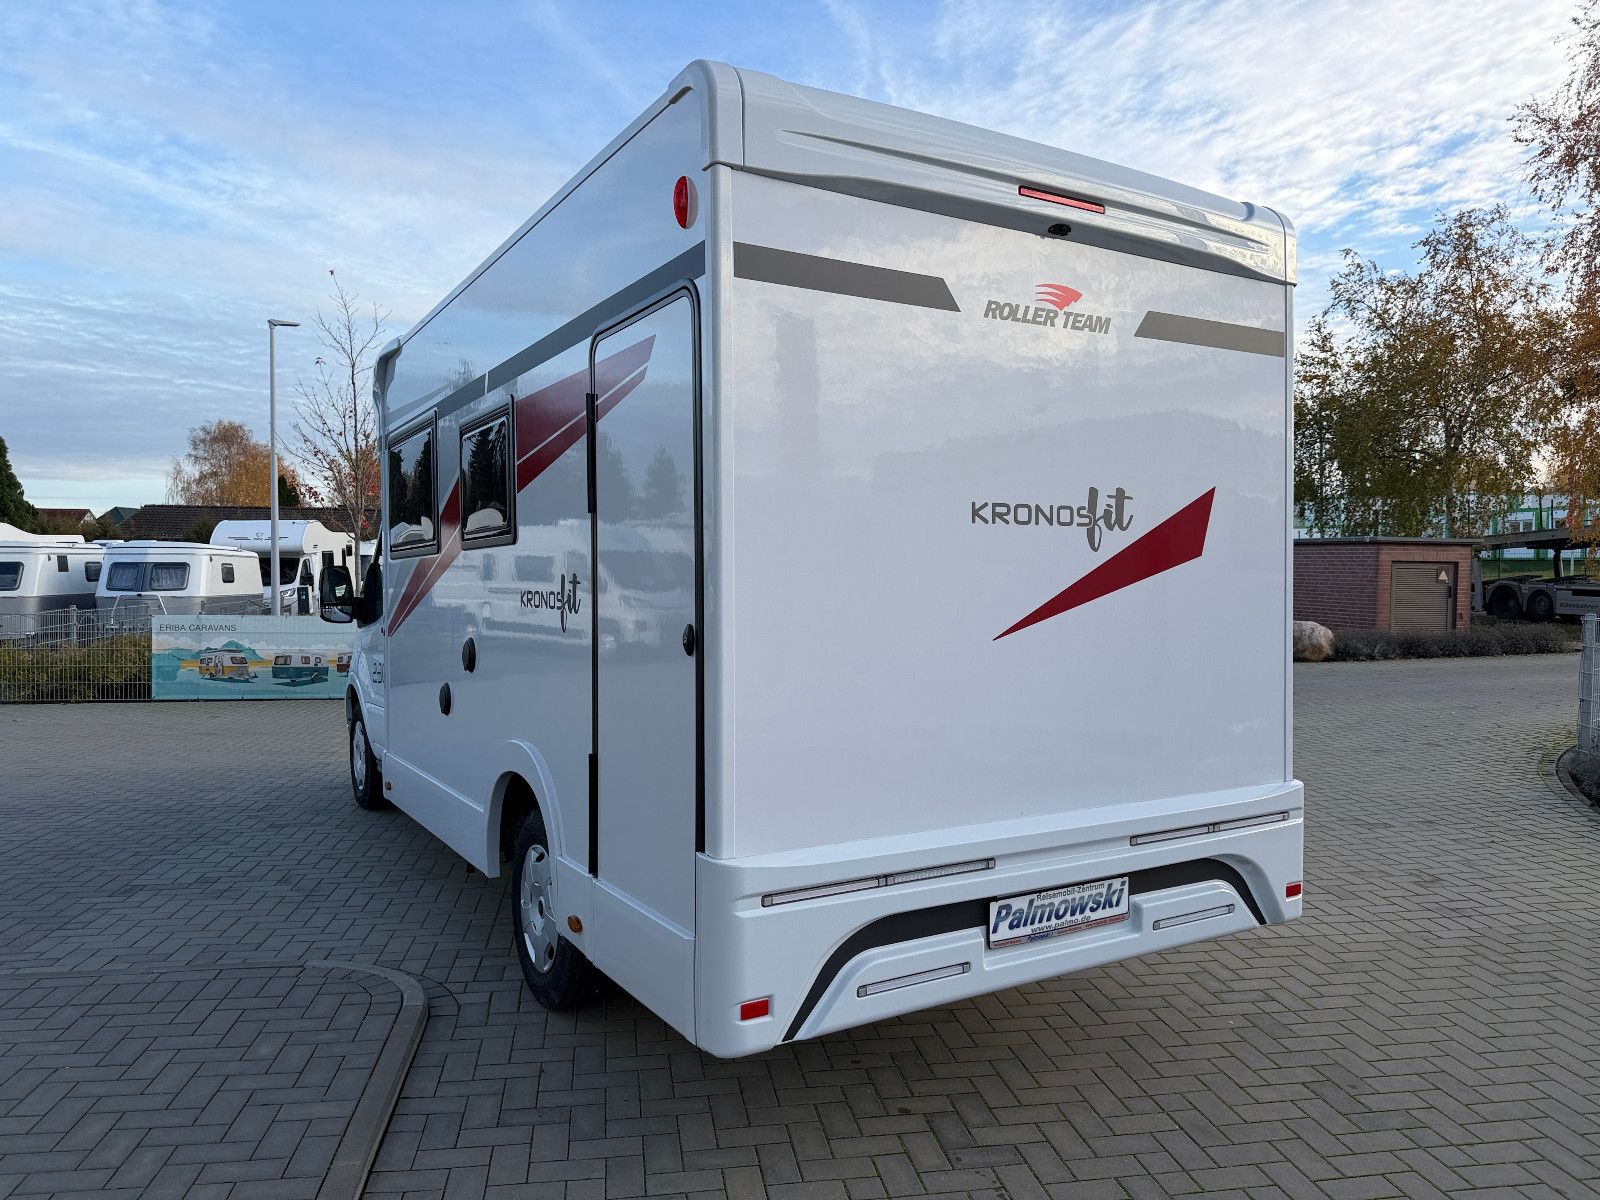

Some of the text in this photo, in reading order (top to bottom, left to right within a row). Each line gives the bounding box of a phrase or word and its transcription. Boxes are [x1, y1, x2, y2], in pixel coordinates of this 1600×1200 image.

[983, 299, 1112, 335] ROLLER TEAM
[159, 623, 237, 632] ERIBA CARAVANS
[1036, 882, 1105, 902] Reisemobil-Zentrum
[991, 880, 1127, 935] Palmowski
[1030, 914, 1092, 934] www.palmo.de
